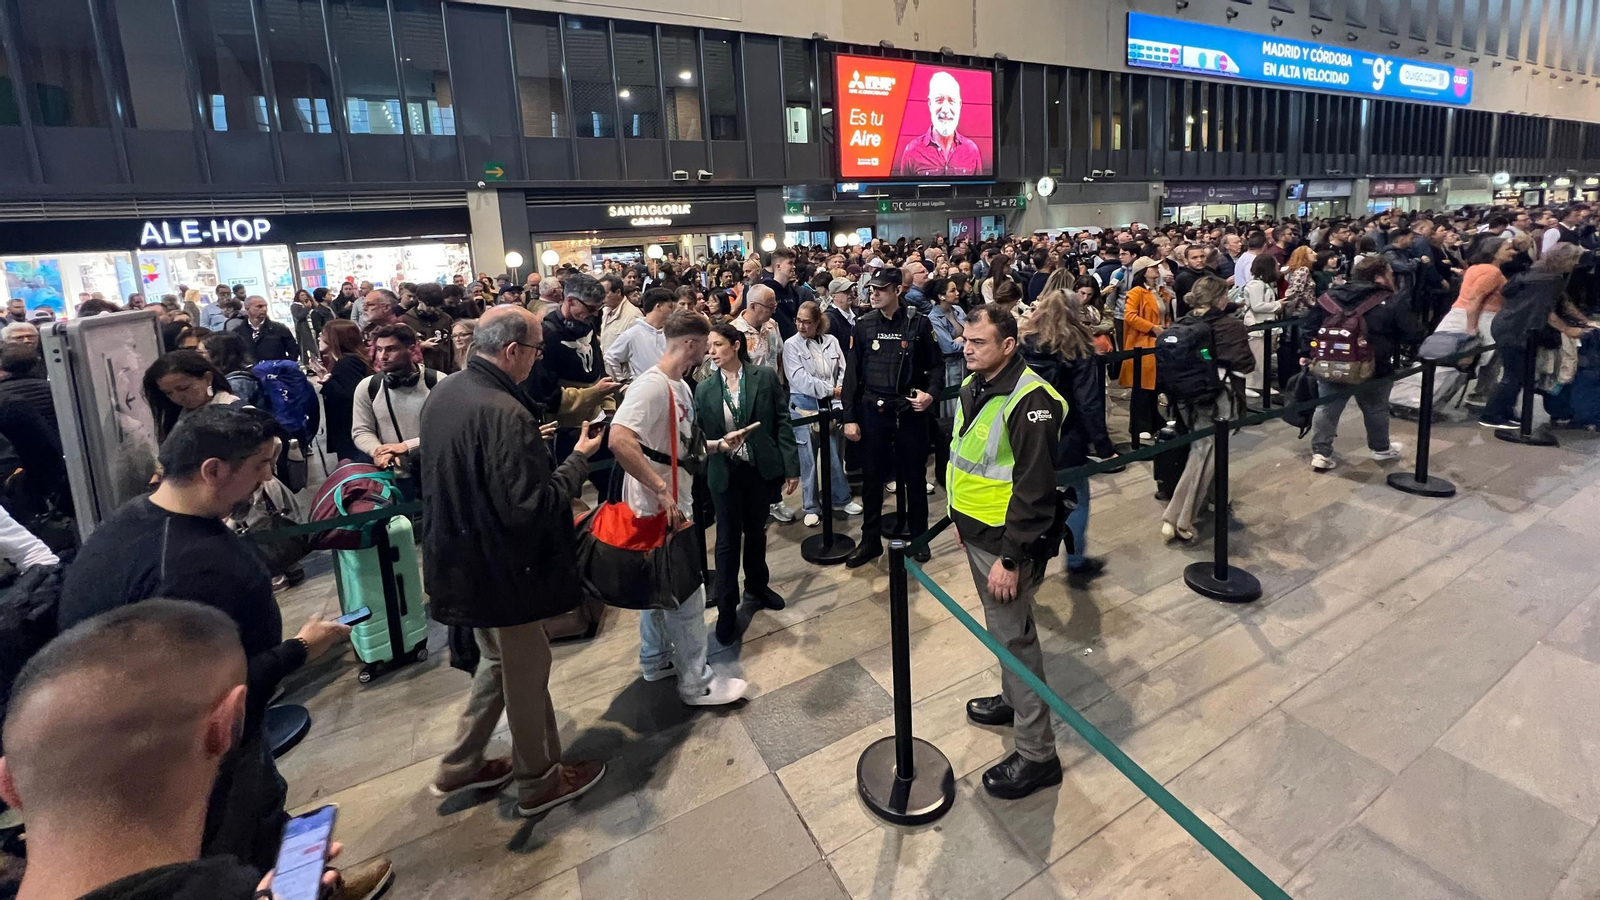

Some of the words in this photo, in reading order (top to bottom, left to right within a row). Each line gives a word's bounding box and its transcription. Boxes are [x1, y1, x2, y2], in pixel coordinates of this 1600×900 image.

[1262, 41, 1300, 59] MADRID
[1302, 48, 1310, 60] Y
[1310, 46, 1352, 67] CÓRDOBA
[1263, 62, 1278, 76] EN
[1278, 63, 1300, 79] ALTA
[1302, 66, 1350, 85] VELOCIDAD
[849, 108, 867, 126] Es
[870, 111, 884, 126] tu
[849, 130, 881, 147] Aire
[608, 204, 691, 217] SANTAGLORIA
[1009, 198, 1017, 207] P2
[140, 218, 272, 246] ALE-HOP
